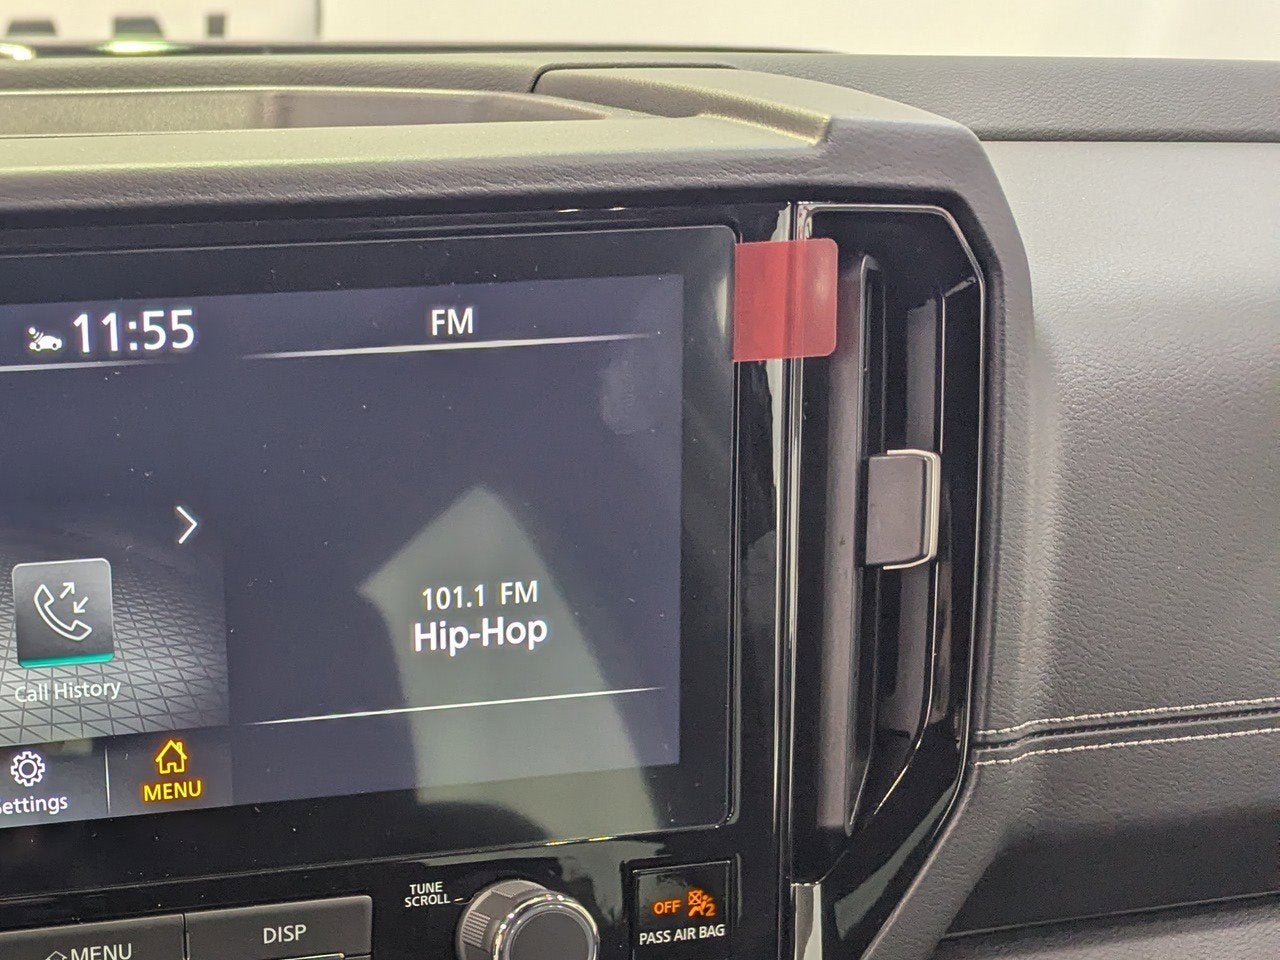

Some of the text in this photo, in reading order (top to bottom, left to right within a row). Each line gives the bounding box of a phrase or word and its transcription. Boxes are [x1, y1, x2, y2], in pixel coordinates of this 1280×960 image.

[73, 309, 196, 354] 11:55
[431, 308, 474, 336] FM
[422, 580, 538, 611] 101.1 FM
[413, 617, 548, 656] Hip-Hop
[15, 680, 121, 704] Call History
[143, 780, 202, 803] MENU
[410, 881, 443, 895] TUNE
[405, 893, 450, 908] SCROLL
[654, 900, 680, 915] OFF
[263, 925, 307, 944] DISP
[639, 924, 725, 945] PASS AIR BAG
